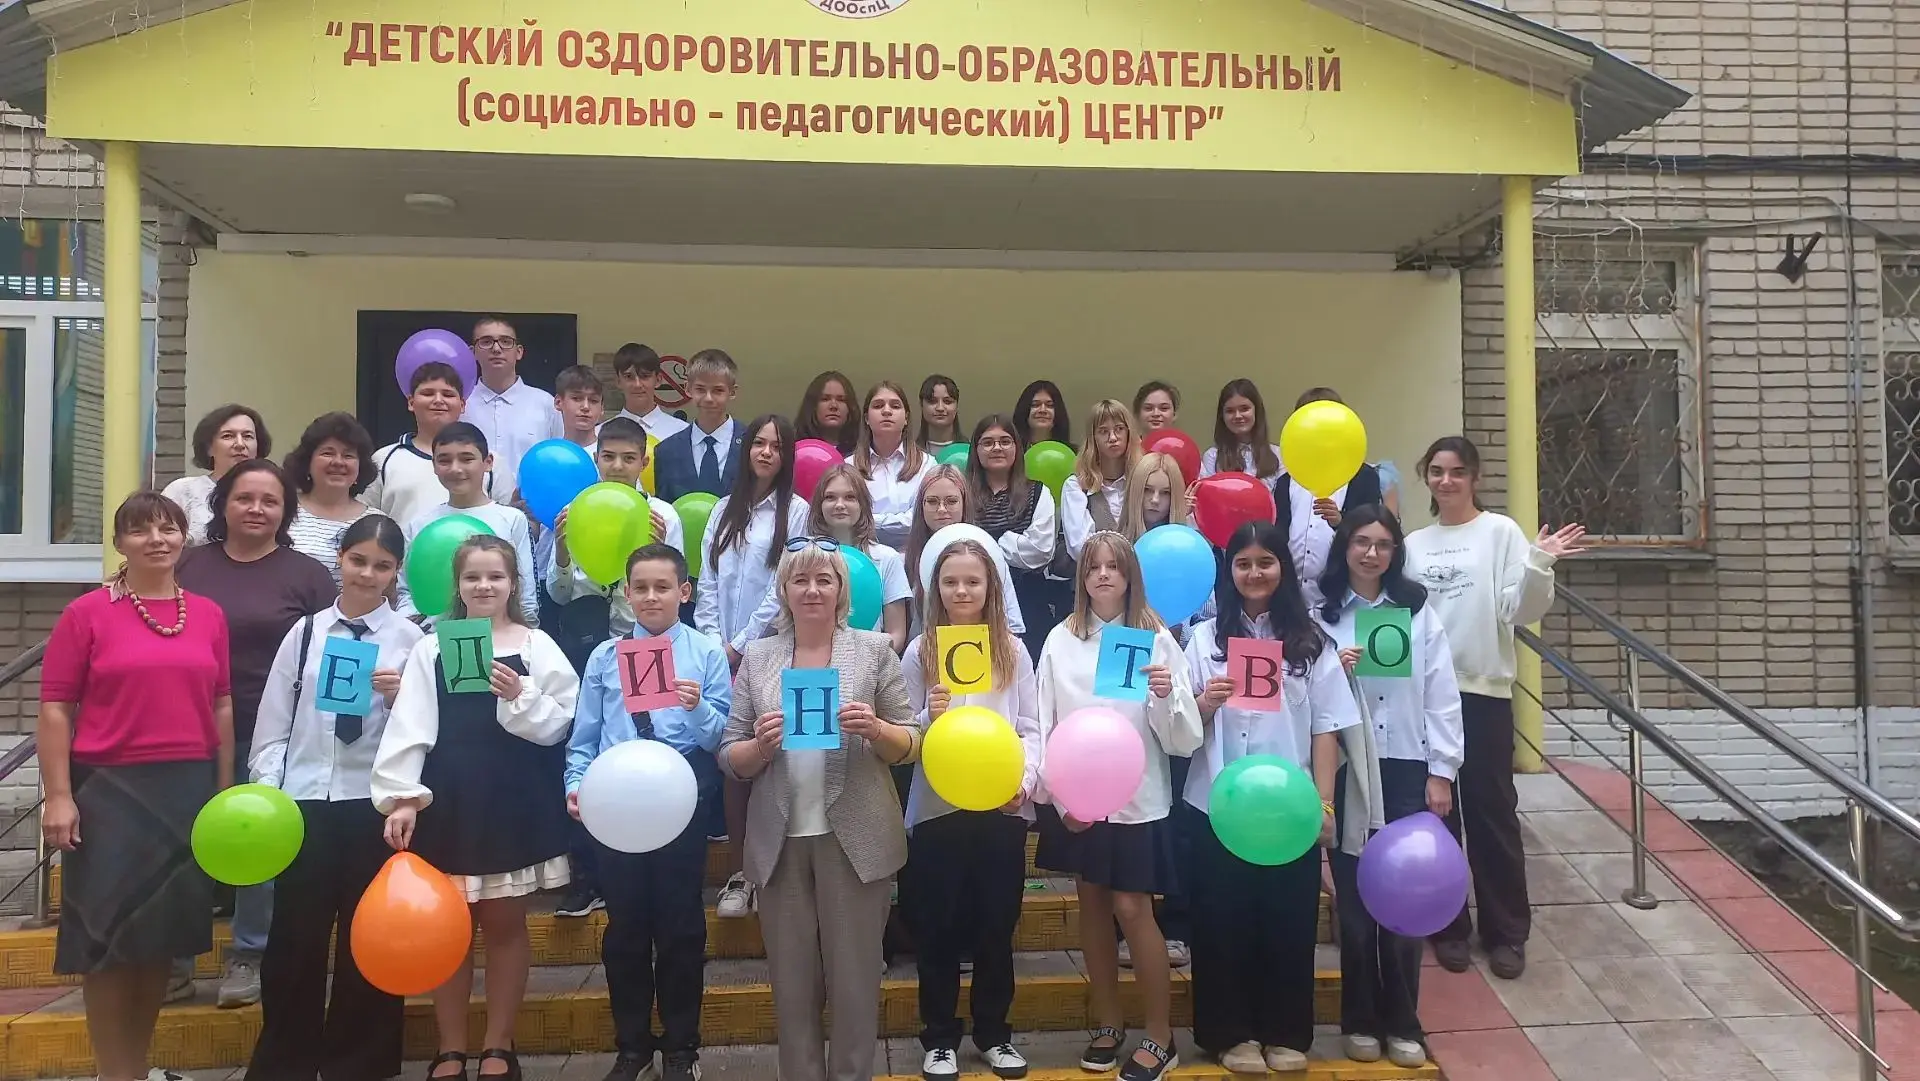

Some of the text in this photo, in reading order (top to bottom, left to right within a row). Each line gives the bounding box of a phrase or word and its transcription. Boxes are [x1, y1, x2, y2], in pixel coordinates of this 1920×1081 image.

[325, 18, 1341, 91] “ДЕТСКИЙ ОЗДОРОВИТЕЛЬНО-ОБРАЗОВАТЕЛЬНЫЙ
[457, 76, 697, 129] (социально
[736, 96, 1069, 144] педагогический)
[1084, 102, 1224, 145] ЦЕНТР”
[449, 636, 492, 692] Д
[945, 641, 985, 685] С
[1114, 643, 1151, 690] Т
[1368, 624, 1410, 668] О
[320, 653, 361, 703] Е
[622, 648, 677, 698] И
[1240, 655, 1280, 699] В
[787, 687, 839, 736] Н
